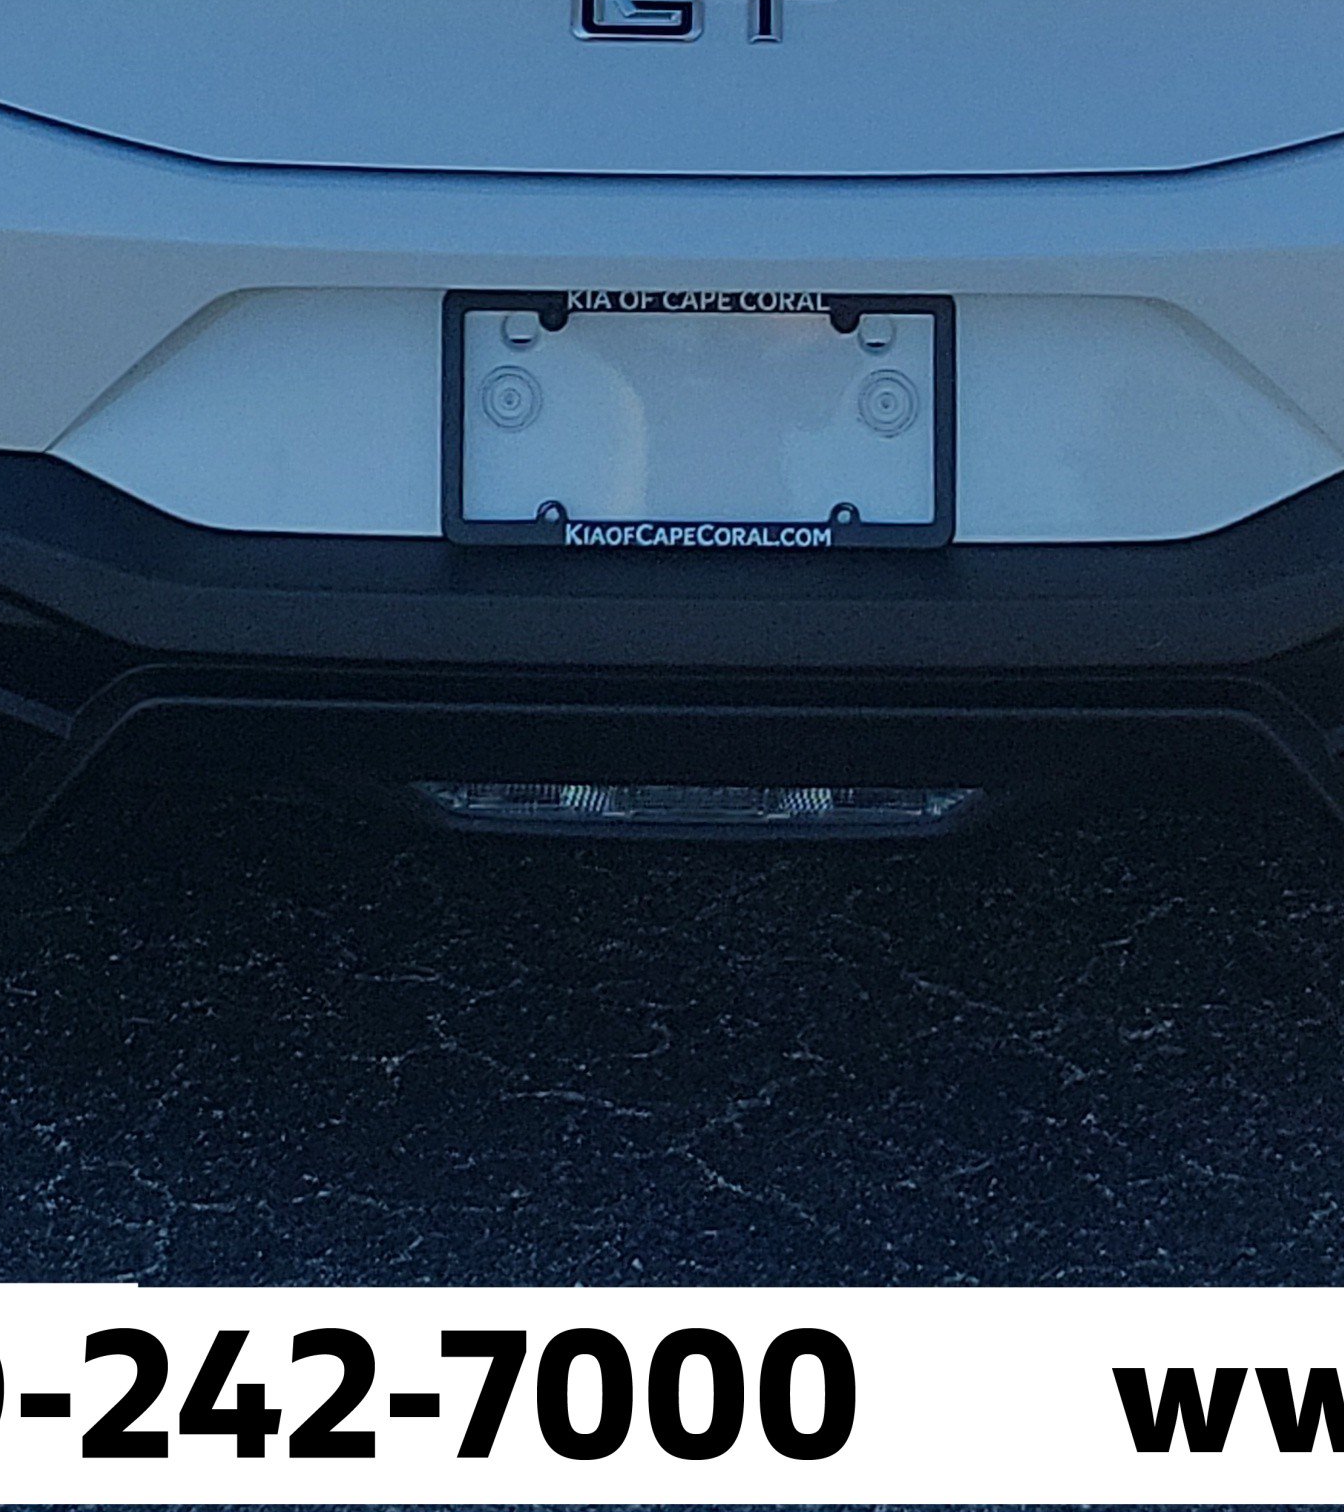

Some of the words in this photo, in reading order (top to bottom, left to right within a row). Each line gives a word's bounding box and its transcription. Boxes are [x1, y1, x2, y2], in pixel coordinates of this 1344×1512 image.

[567, 290, 612, 309] KIA
[618, 291, 656, 310] OF
[662, 291, 733, 311] CAPE
[739, 291, 832, 312] CORAL
